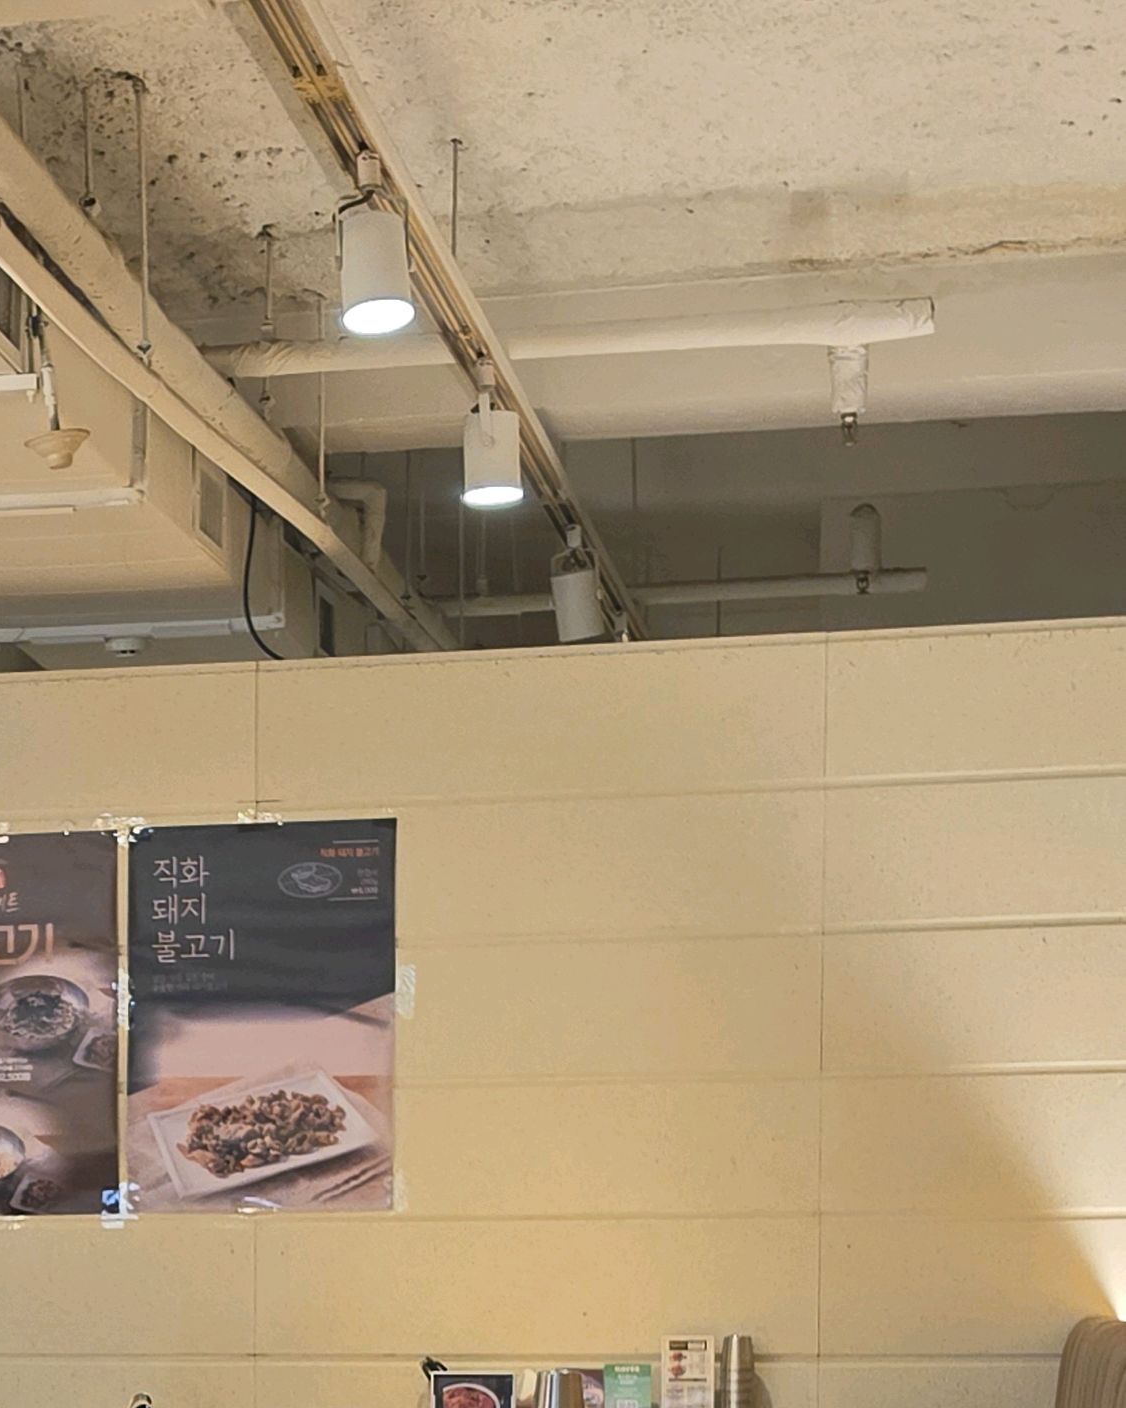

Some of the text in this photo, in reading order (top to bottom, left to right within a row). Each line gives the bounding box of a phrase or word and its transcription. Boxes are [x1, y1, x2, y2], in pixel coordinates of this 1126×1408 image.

[153, 855, 210, 888] 직화
[152, 892, 206, 925] 돼지
[151, 928, 235, 964] 불고기
